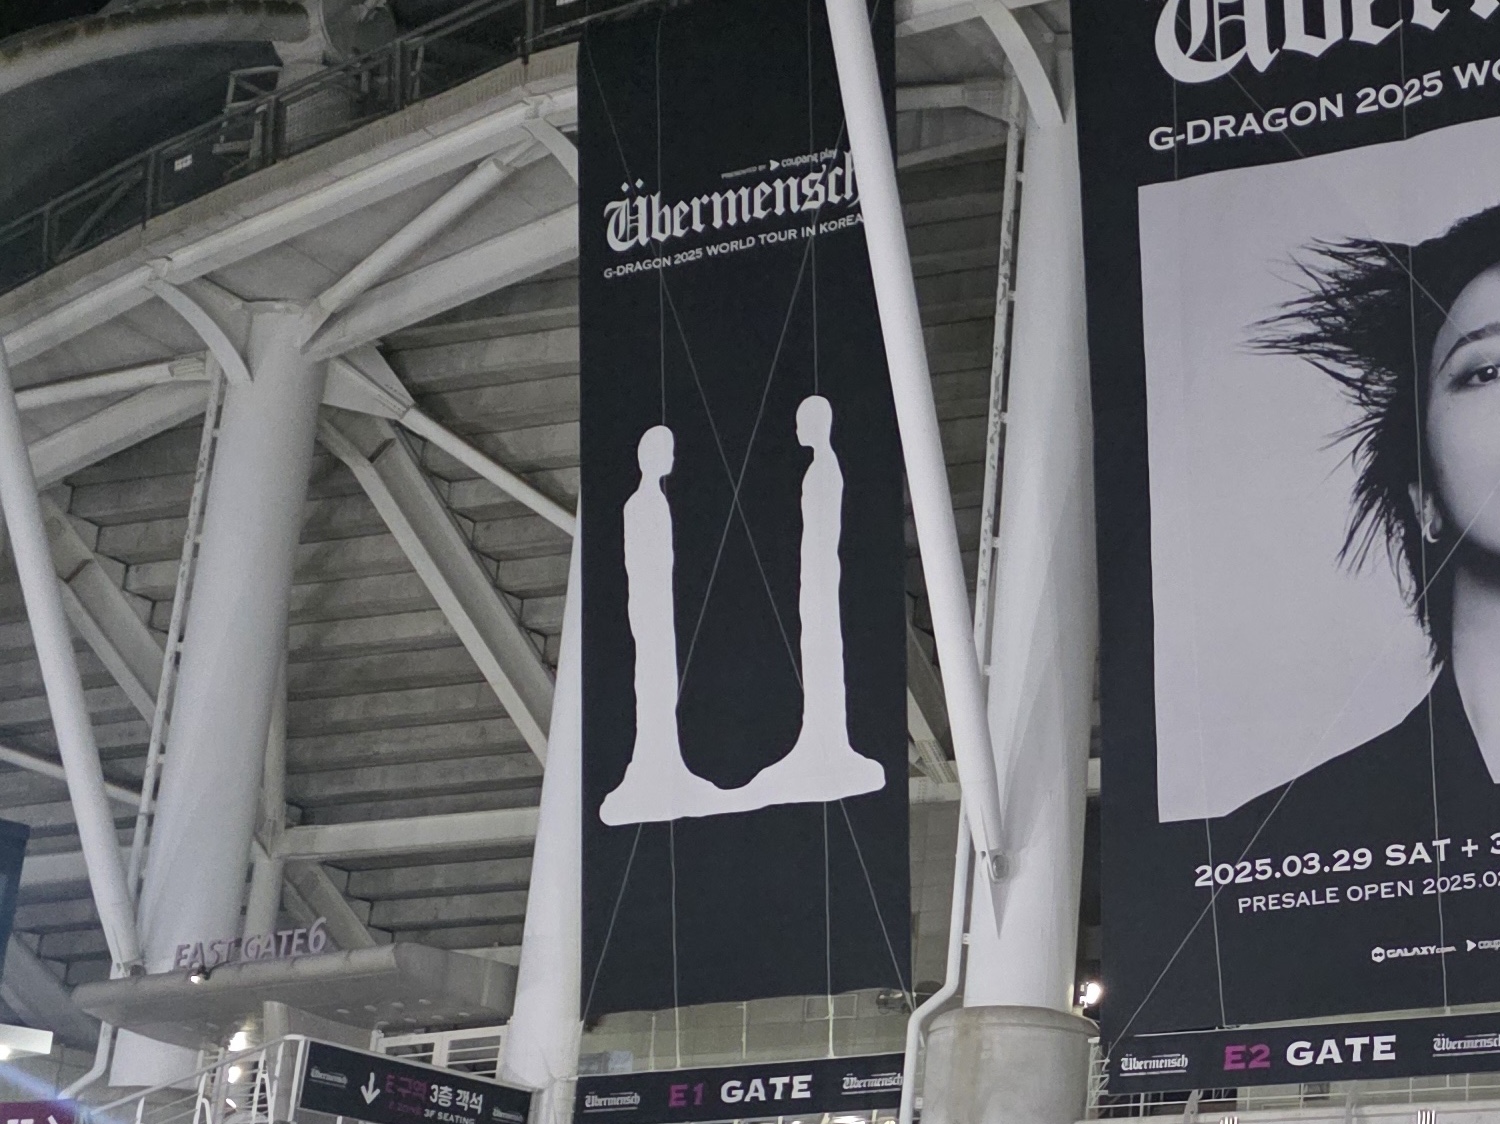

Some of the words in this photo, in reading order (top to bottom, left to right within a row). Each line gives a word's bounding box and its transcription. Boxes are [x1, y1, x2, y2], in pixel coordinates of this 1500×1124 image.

[1148, 93, 1345, 150] G-DRAGON
[1355, 70, 1443, 115] 2025
[604, 256, 672, 279] G-DRAGON
[673, 247, 703, 266] 2025
[706, 236, 756, 257] WORLD
[758, 228, 797, 246] TOUR
[801, 224, 817, 238] IN
[819, 212, 865, 234] KOREA
[1194, 847, 1372, 887] 2025.03.29
[1385, 837, 1451, 867] SAT
[1461, 838, 1479, 858] +
[1237, 886, 1340, 914] PRESALE
[1346, 880, 1414, 902] OPEN
[173, 937, 236, 969] EAST
[1120, 1054, 1189, 1072] Übermensch
[1223, 1043, 1271, 1071] E2
[1286, 1035, 1397, 1067] GATE
[429, 1084, 452, 1108] 3층
[456, 1089, 483, 1115] 객석
[668, 1082, 704, 1108] E1
[721, 1074, 812, 1104] GATE
